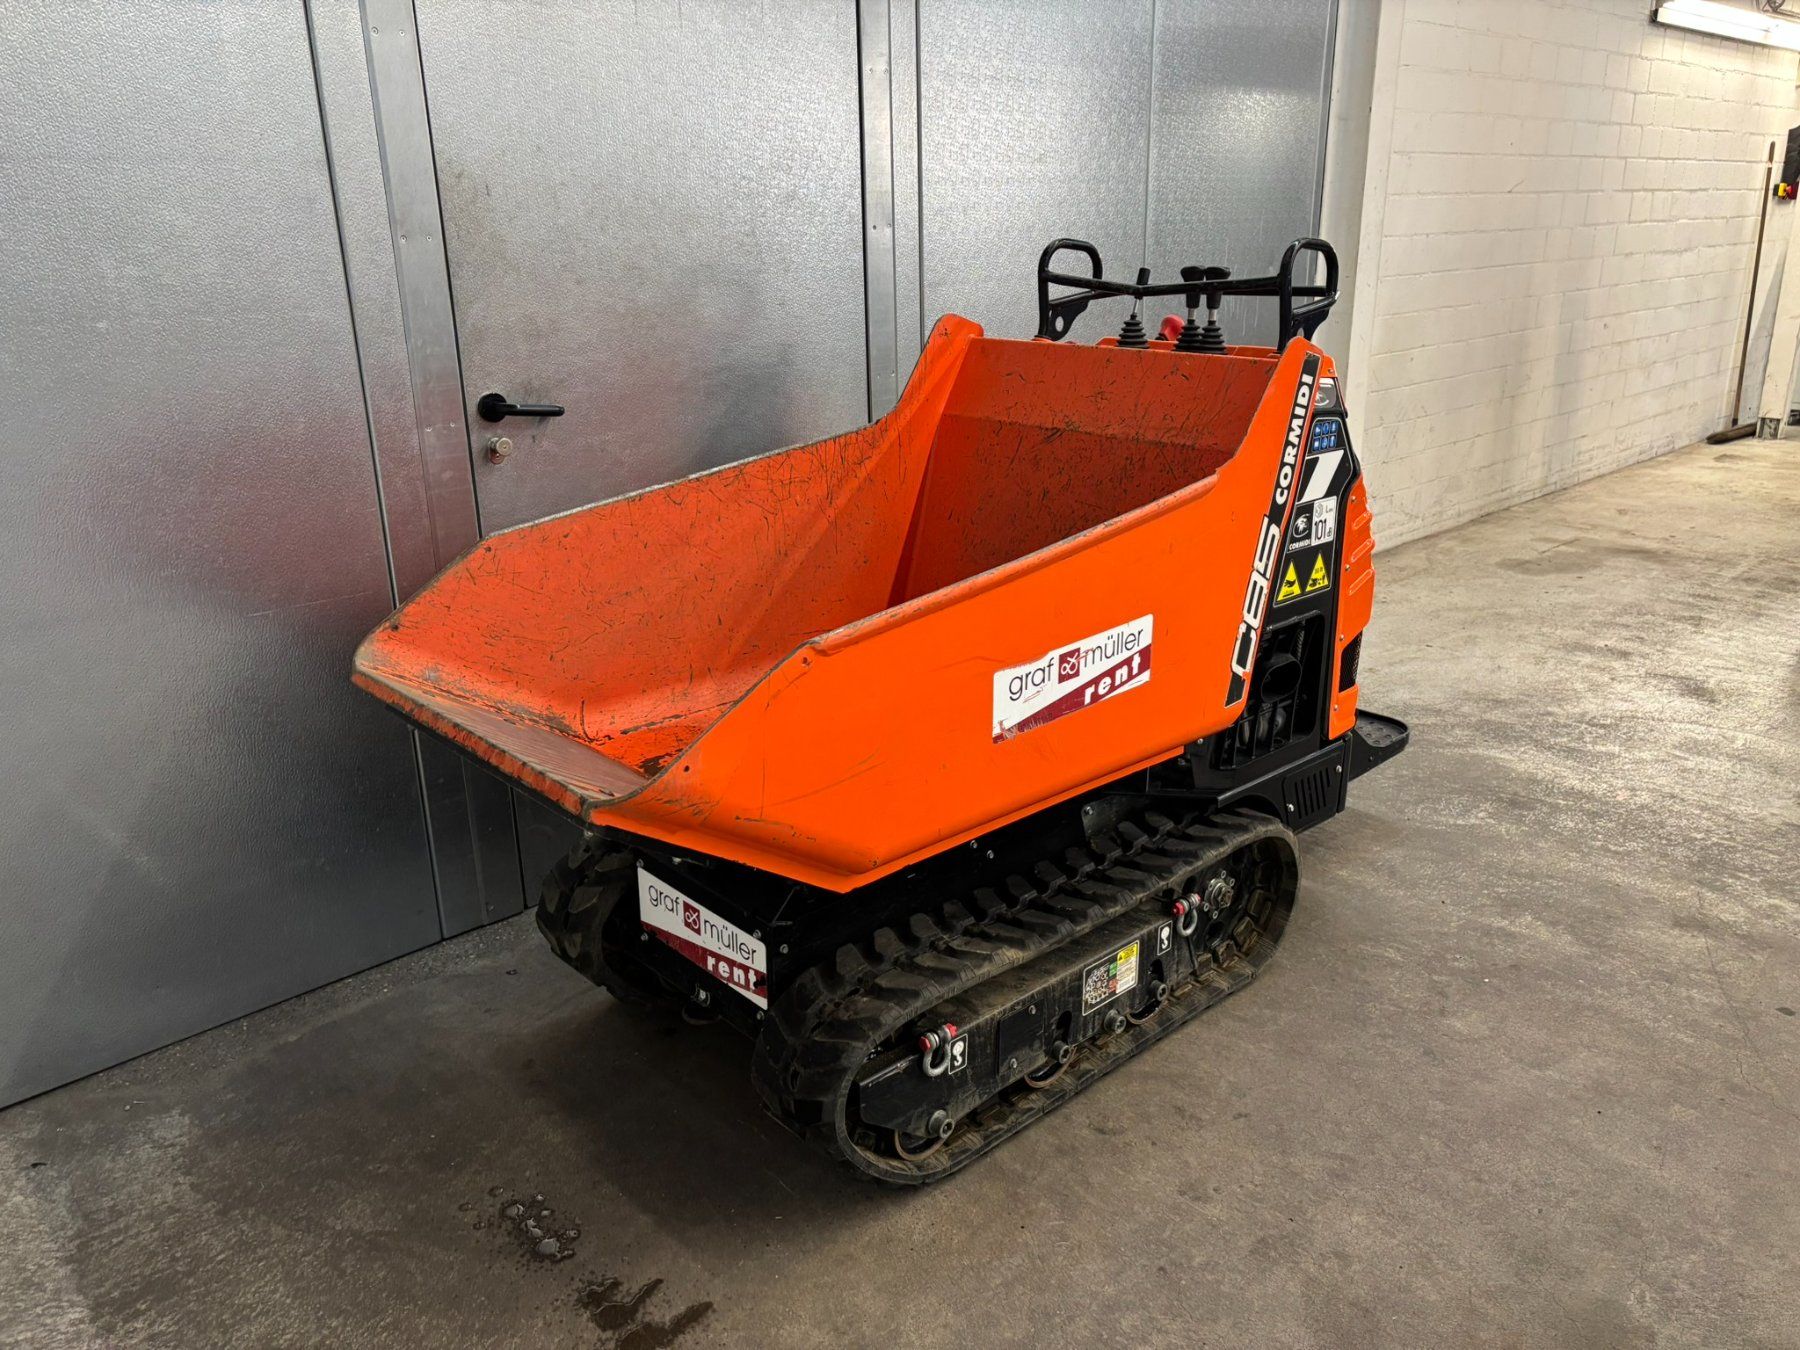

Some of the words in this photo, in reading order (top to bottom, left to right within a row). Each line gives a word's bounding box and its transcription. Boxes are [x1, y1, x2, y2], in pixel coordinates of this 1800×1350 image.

[1275, 373, 1314, 505] CORMIDI
[1314, 518, 1327, 541] 101
[1231, 515, 1281, 677] C85
[1009, 656, 1055, 702] graf
[1083, 628, 1144, 668] müller
[1083, 652, 1142, 705] rent
[648, 884, 680, 916] graf
[703, 917, 757, 965] müller
[706, 953, 757, 991] rent
